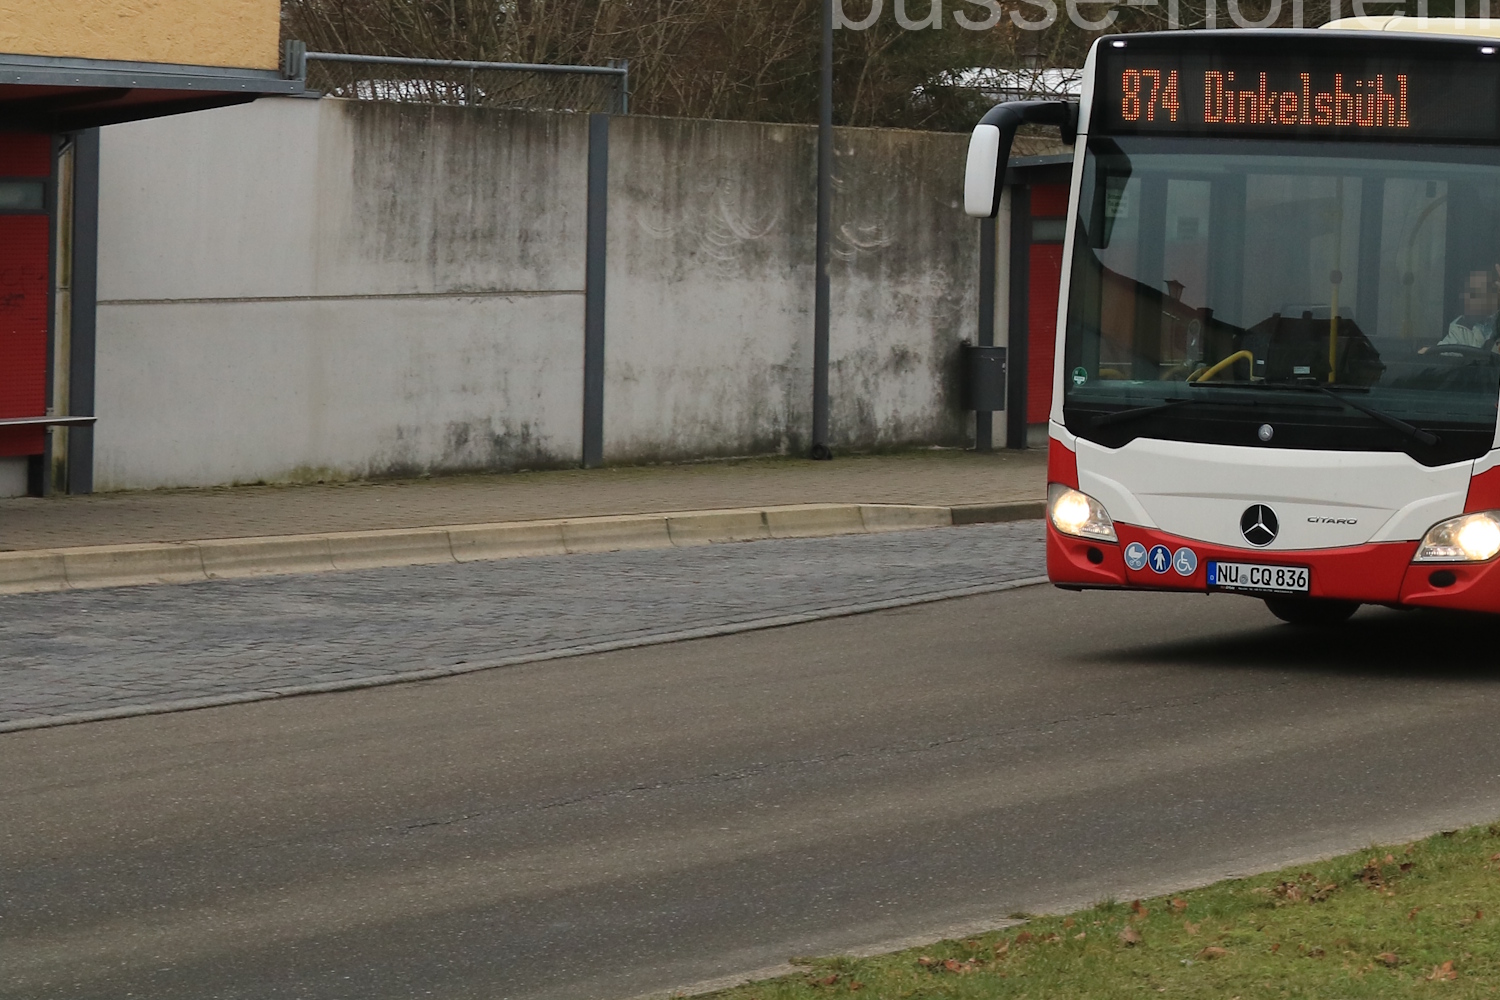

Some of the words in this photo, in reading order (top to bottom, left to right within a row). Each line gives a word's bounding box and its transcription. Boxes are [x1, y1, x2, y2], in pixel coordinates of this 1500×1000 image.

[1121, 68, 1180, 122] 874
[1203, 69, 1411, 128] Dinkelsbühl
[1307, 516, 1358, 525] CITARO
[1217, 564, 1239, 583] NU
[1250, 567, 1272, 586] CQ
[1275, 569, 1307, 588] 836
